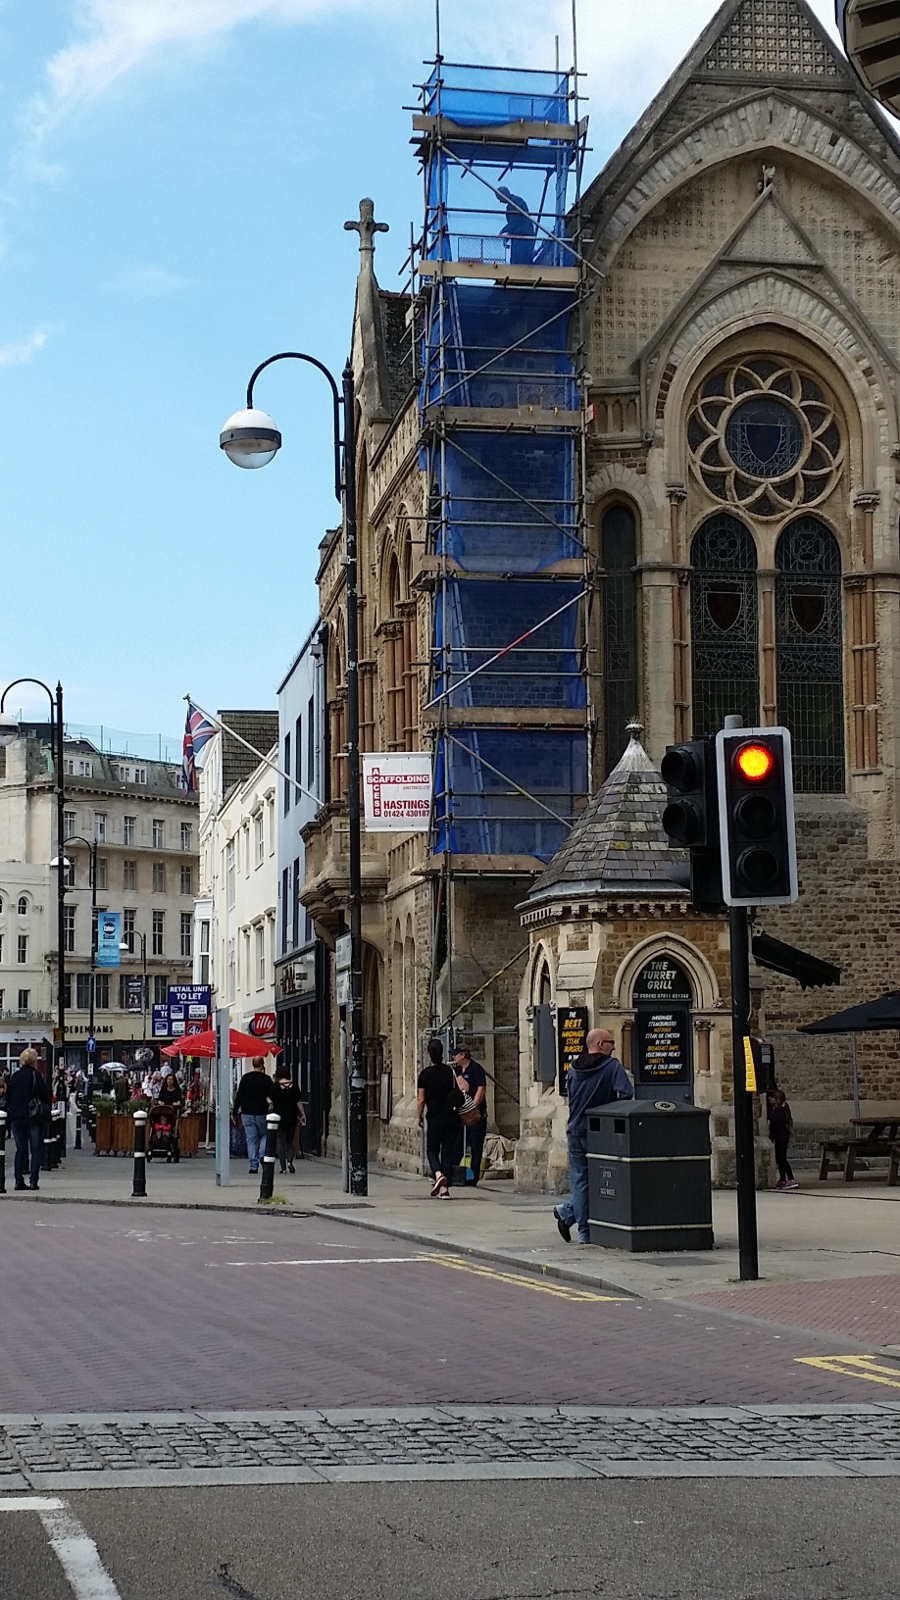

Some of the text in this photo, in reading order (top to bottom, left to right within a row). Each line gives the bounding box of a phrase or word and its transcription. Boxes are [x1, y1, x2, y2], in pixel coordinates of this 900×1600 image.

[367, 775, 429, 783] SCAFFOLDING
[372, 768, 381, 816] ACCESS
[383, 800, 430, 809] HASTINGS
[651, 961, 669, 970] THE
[642, 970, 677, 980] TURRET
[647, 980, 672, 990] GRILL
[256, 1015, 274, 1031] illy
[564, 1019, 582, 1028] BEST
